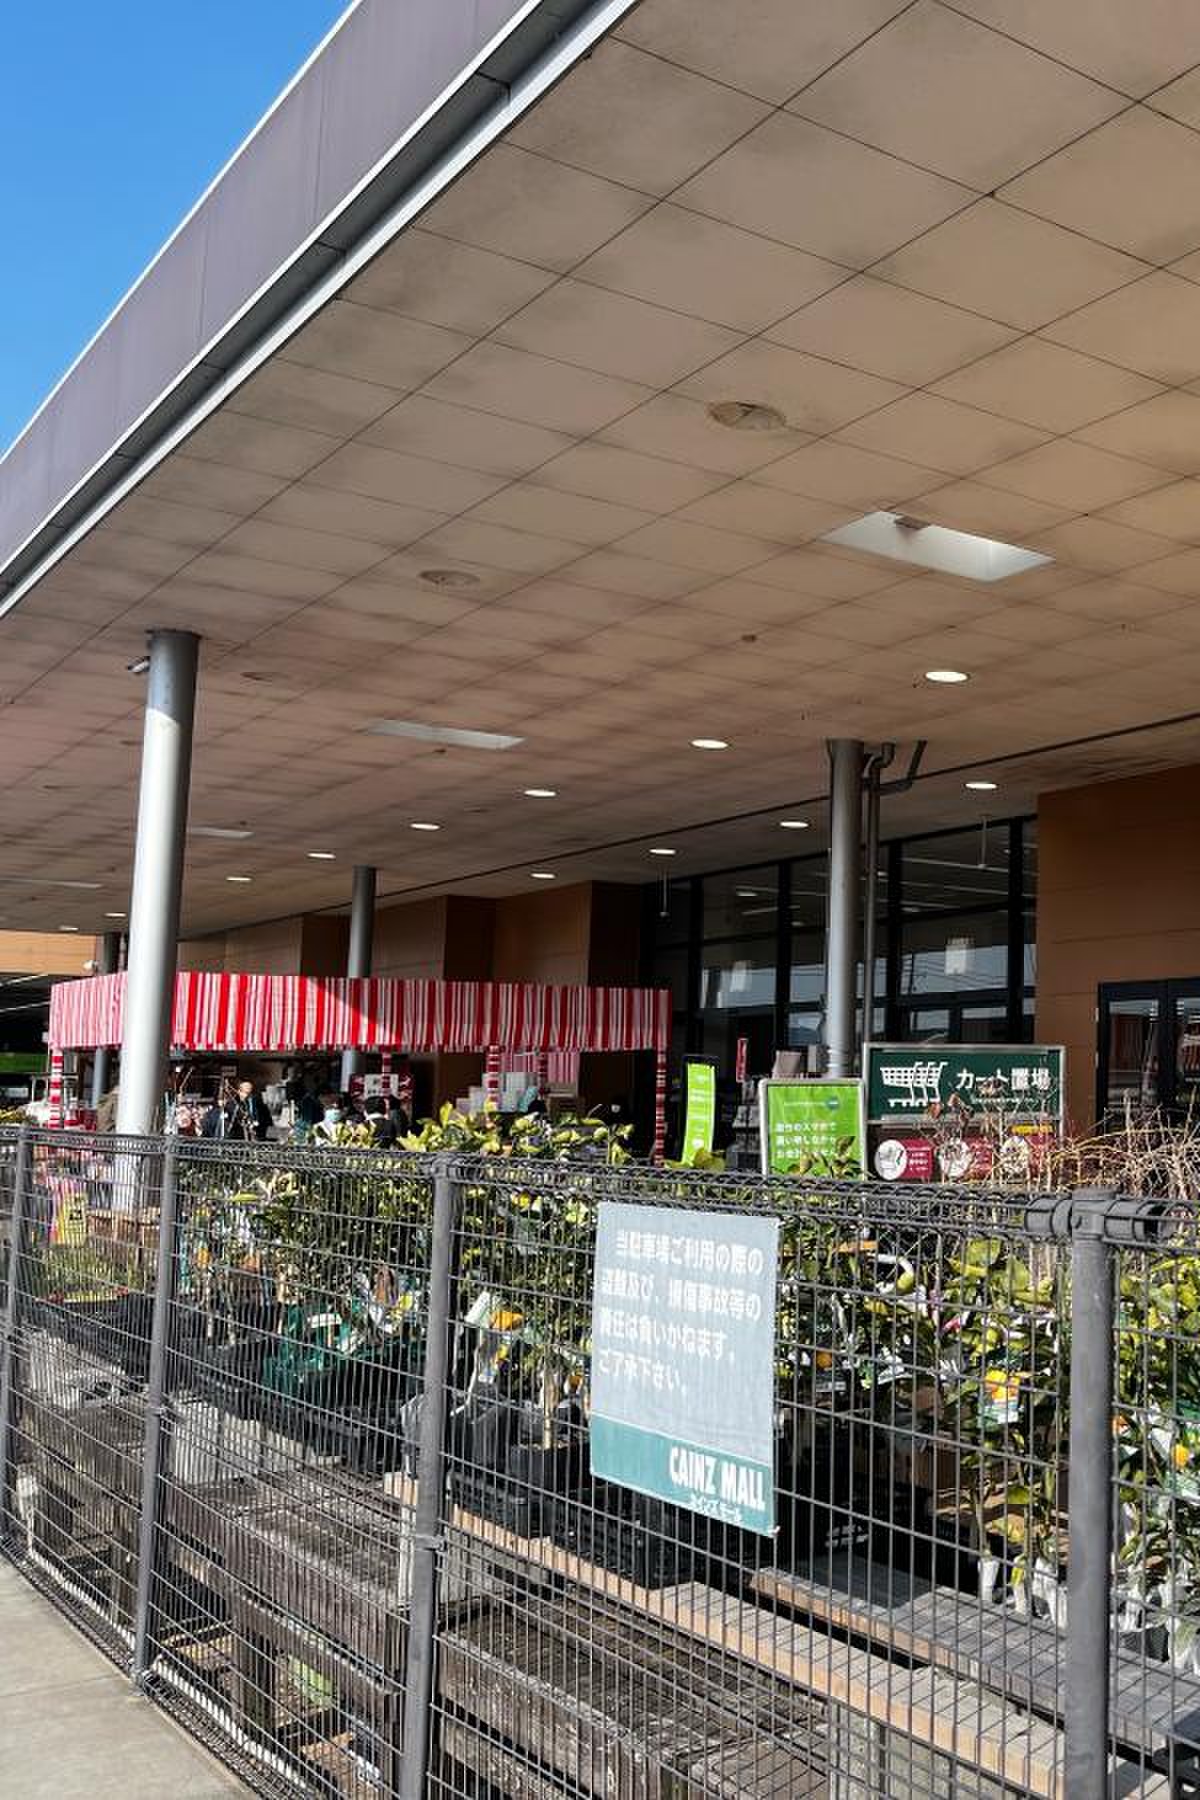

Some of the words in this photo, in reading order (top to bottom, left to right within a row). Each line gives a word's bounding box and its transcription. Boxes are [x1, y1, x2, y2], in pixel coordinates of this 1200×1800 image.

[956, 1067, 1050, 1090] カート置場
[616, 1229, 764, 1275] 当駐車場ご利用の際の
[670, 1447, 718, 1494] CAINZ
[720, 1461, 765, 1511] MALL
